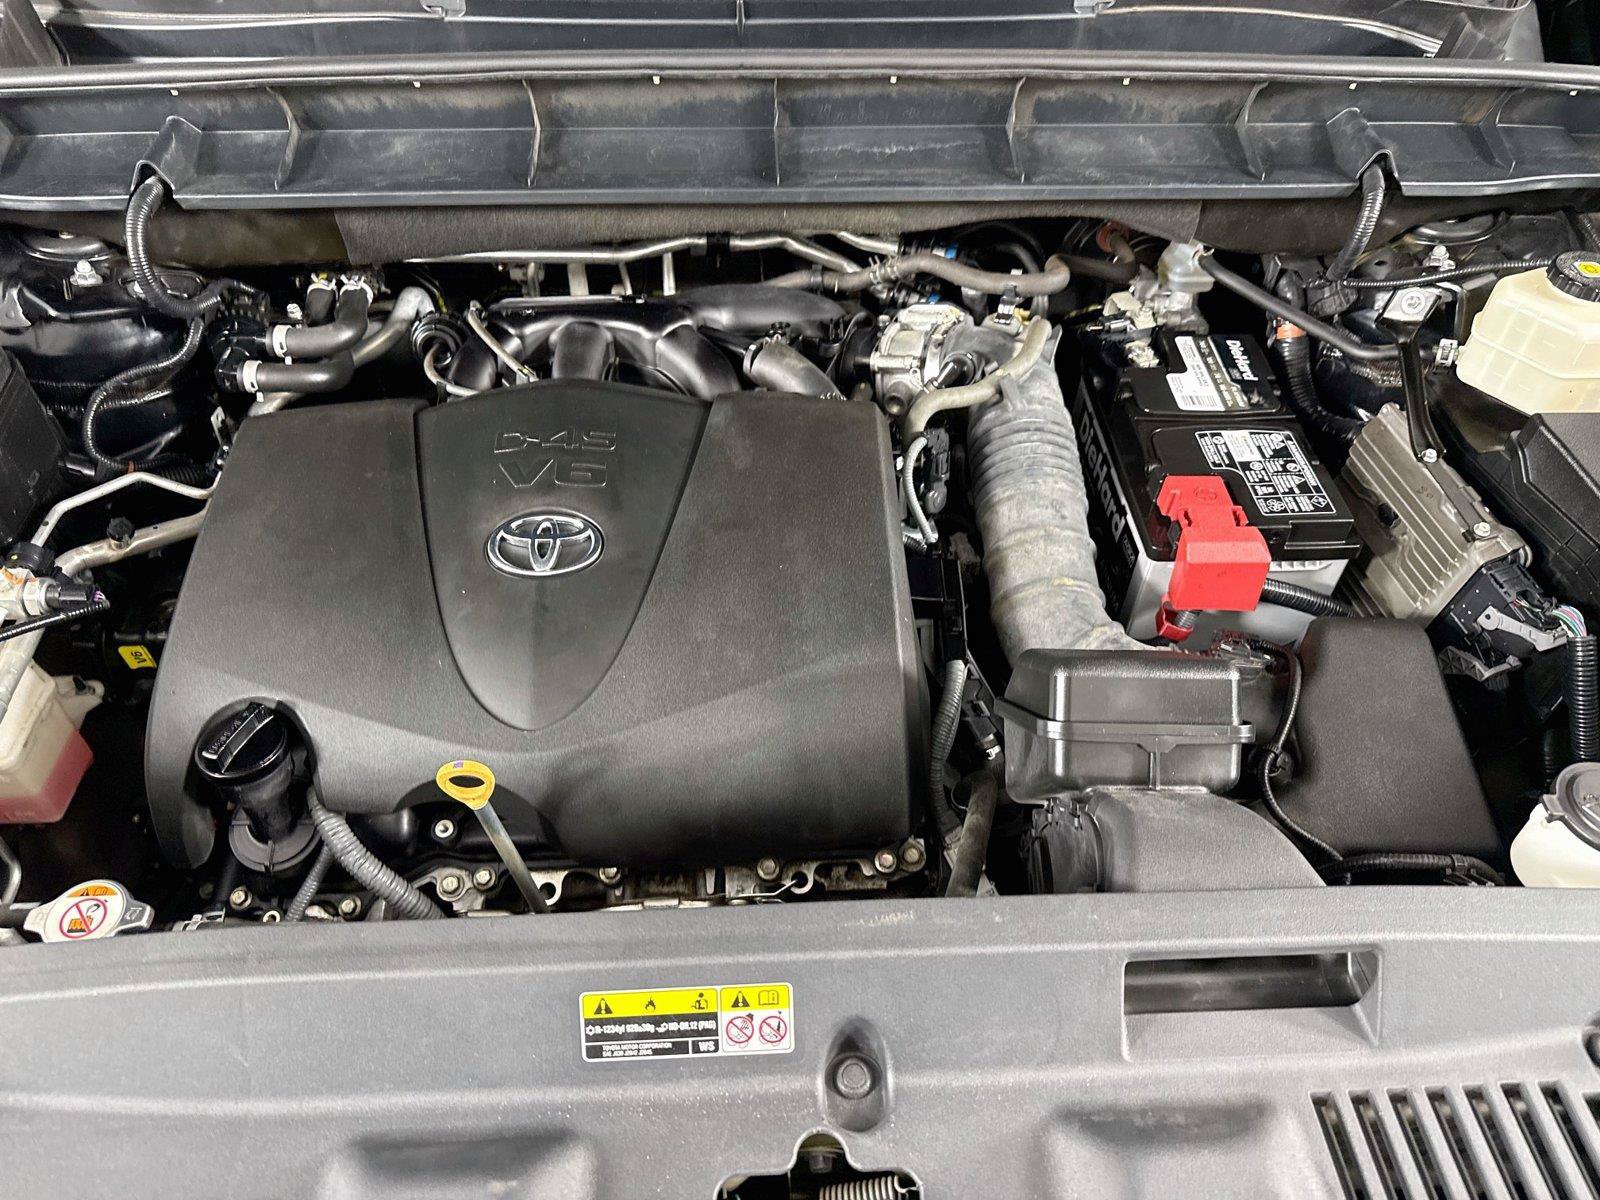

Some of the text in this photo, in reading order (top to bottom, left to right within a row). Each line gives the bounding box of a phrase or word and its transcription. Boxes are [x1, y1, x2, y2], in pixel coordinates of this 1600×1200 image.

[1226, 340, 1258, 381] DieHard
[493, 429, 617, 453] D-4S
[497, 457, 608, 488] V6
[1079, 410, 1126, 543] DieHard
[602, 1044, 620, 1052] TOYOTA
[698, 1041, 715, 1051] WS
